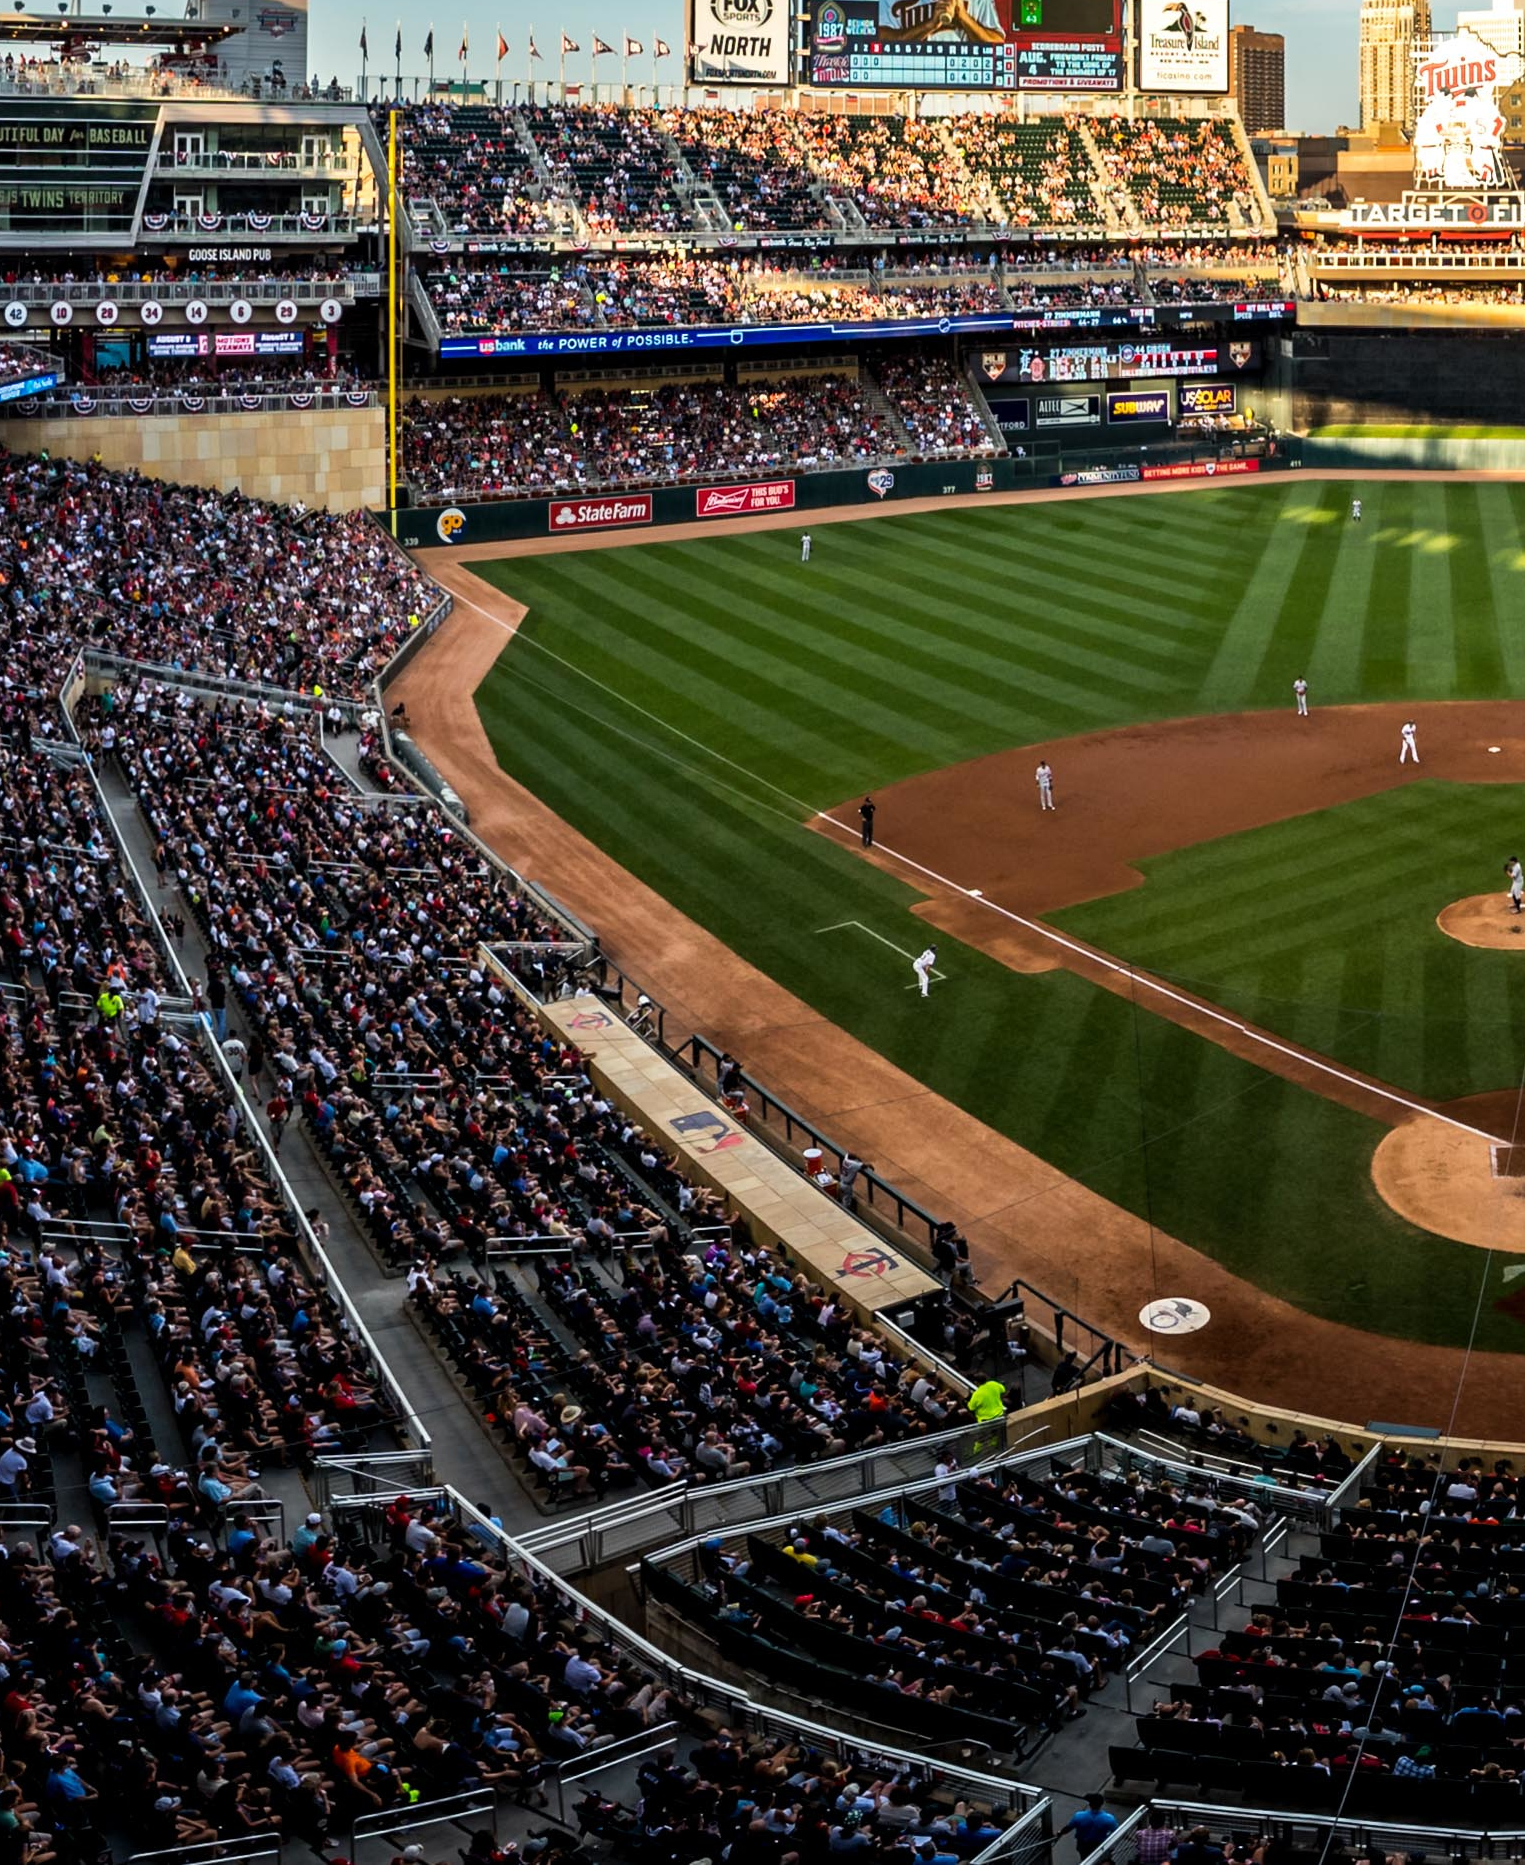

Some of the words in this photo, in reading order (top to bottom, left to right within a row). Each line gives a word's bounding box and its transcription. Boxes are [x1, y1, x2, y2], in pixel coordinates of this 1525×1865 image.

[723, 12, 760, 22] SPORTS
[819, 23, 843, 37] 1987
[710, 35, 771, 57] NORTH
[1031, 42, 1079, 51] SCOREBOARD
[1082, 43, 1105, 52] POSTS
[1149, 34, 1185, 49] Treasure
[1194, 35, 1219, 50] Island
[1019, 51, 1047, 63] AUG.
[1050, 53, 1089, 61] FIREWORKS
[1091, 54, 1116, 62] FRIDAY
[1028, 64, 1037, 75] 4
[1068, 61, 1081, 69] THE
[1083, 61, 1100, 69] SONG
[1023, 78, 1067, 86] PROMOTIONS
[1077, 79, 1115, 87] GIVEAWAYS
[1419, 57, 1497, 97] Twins
[43, 128, 65, 143] DAY
[89, 128, 147, 144] BASEBALL
[7, 190, 18, 204] IS
[22, 191, 64, 208] TWINS
[69, 190, 124, 205] TERRITORY
[1351, 204, 1464, 223] TARGET
[189, 248, 218, 261] GOOSE
[219, 248, 251, 261] ISLAND
[253, 248, 271, 261] PUB
[9, 308, 22, 319] 42
[56, 308, 67, 319] 10
[101, 308, 115, 319] 28
[145, 307, 158, 319] 34
[191, 307, 202, 318] 14
[237, 306, 244, 317] 6
[280, 305, 292, 317] 29
[328, 305, 335, 317] 3
[1055, 310, 1100, 319] ZIMMERMANN
[538, 340, 553, 350] the
[559, 337, 607, 350] POWER
[612, 336, 623, 349] of
[627, 333, 693, 347] POSSIBLE.
[1197, 389, 1232, 404] SOLAR
[1038, 400, 1061, 414] ALTEC
[1113, 400, 1165, 415] SUBWAY
[1144, 468, 1170, 478] GETTING
[1172, 467, 1190, 476] MORE
[1191, 466, 1205, 474] KIDS
[880, 474, 893, 487] 29
[751, 488, 767, 497] THIS
[768, 484, 789, 495] BUD'S
[942, 486, 956, 494] 377
[708, 495, 744, 505] Budweiser
[751, 498, 766, 507] FOR
[766, 496, 781, 506] YOU.
[441, 515, 463, 535] go
[404, 537, 419, 546] 339
